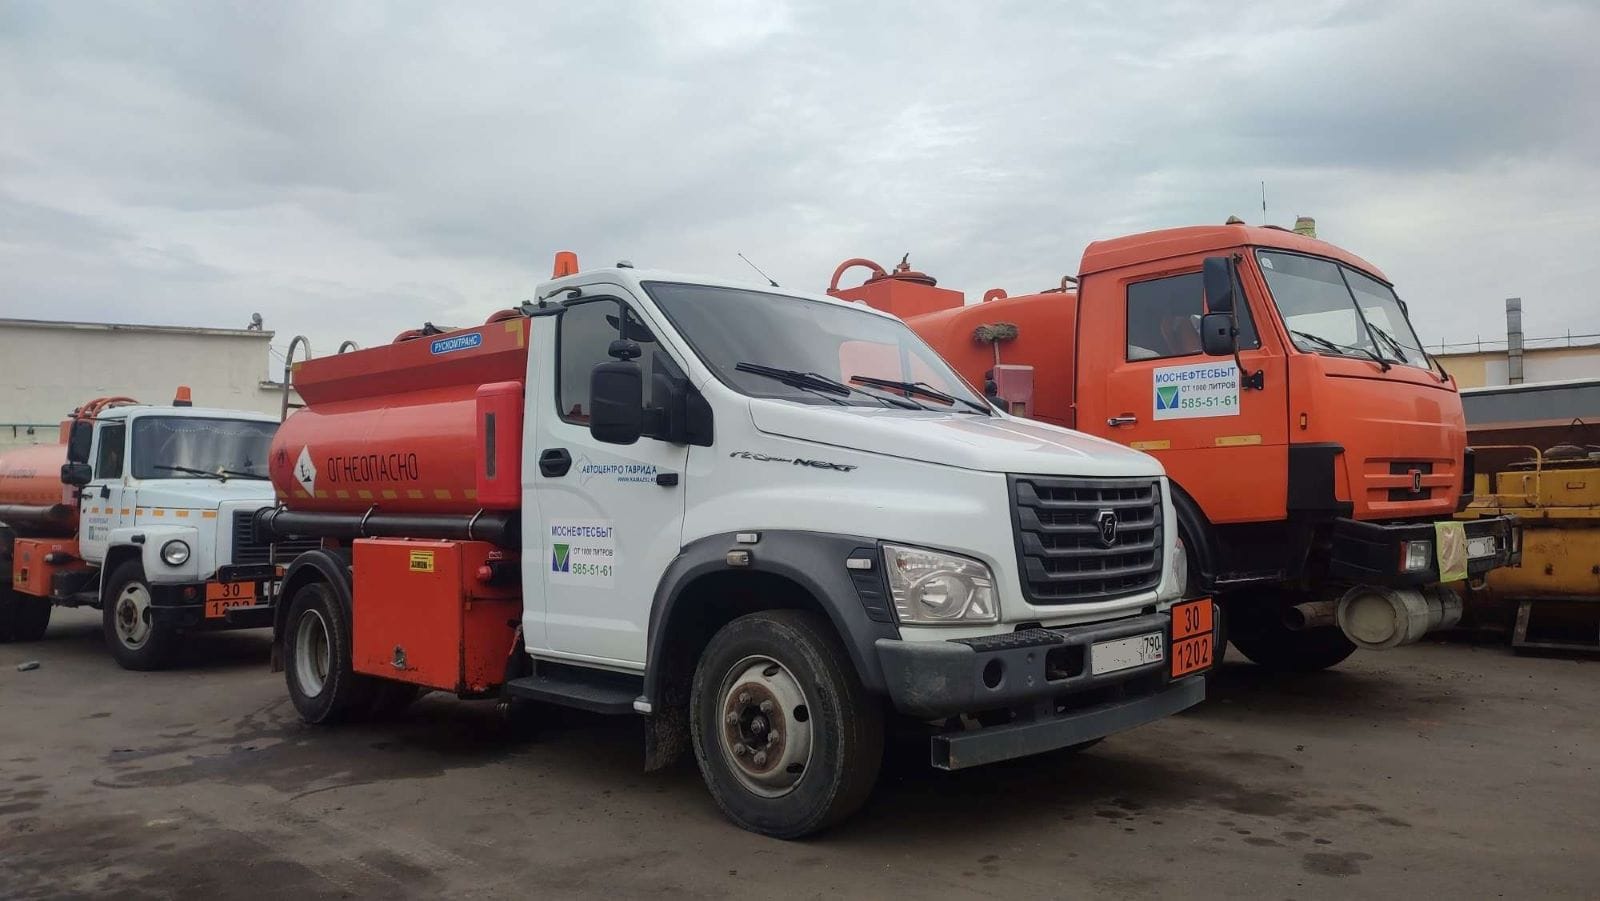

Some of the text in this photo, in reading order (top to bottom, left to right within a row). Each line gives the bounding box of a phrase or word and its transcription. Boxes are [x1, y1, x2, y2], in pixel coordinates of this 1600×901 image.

[1155, 367, 1236, 383] МОСНЕФТЕСБЫТ
[1208, 381, 1236, 390] ЛИТРОВ
[1181, 395, 1237, 409] 585-51-61
[327, 453, 418, 482] ОГНЕОПАСНО
[551, 526, 613, 538] МОСНЕФТЕСБЫТ
[573, 547, 581, 555] ОТ
[593, 548, 613, 556] ЛИТРОВ
[573, 563, 613, 577] 585-51-61
[223, 584, 240, 597] 30
[1185, 606, 1200, 633] 30
[1143, 635, 1161, 654] 790
[1178, 638, 1208, 672] 1202
